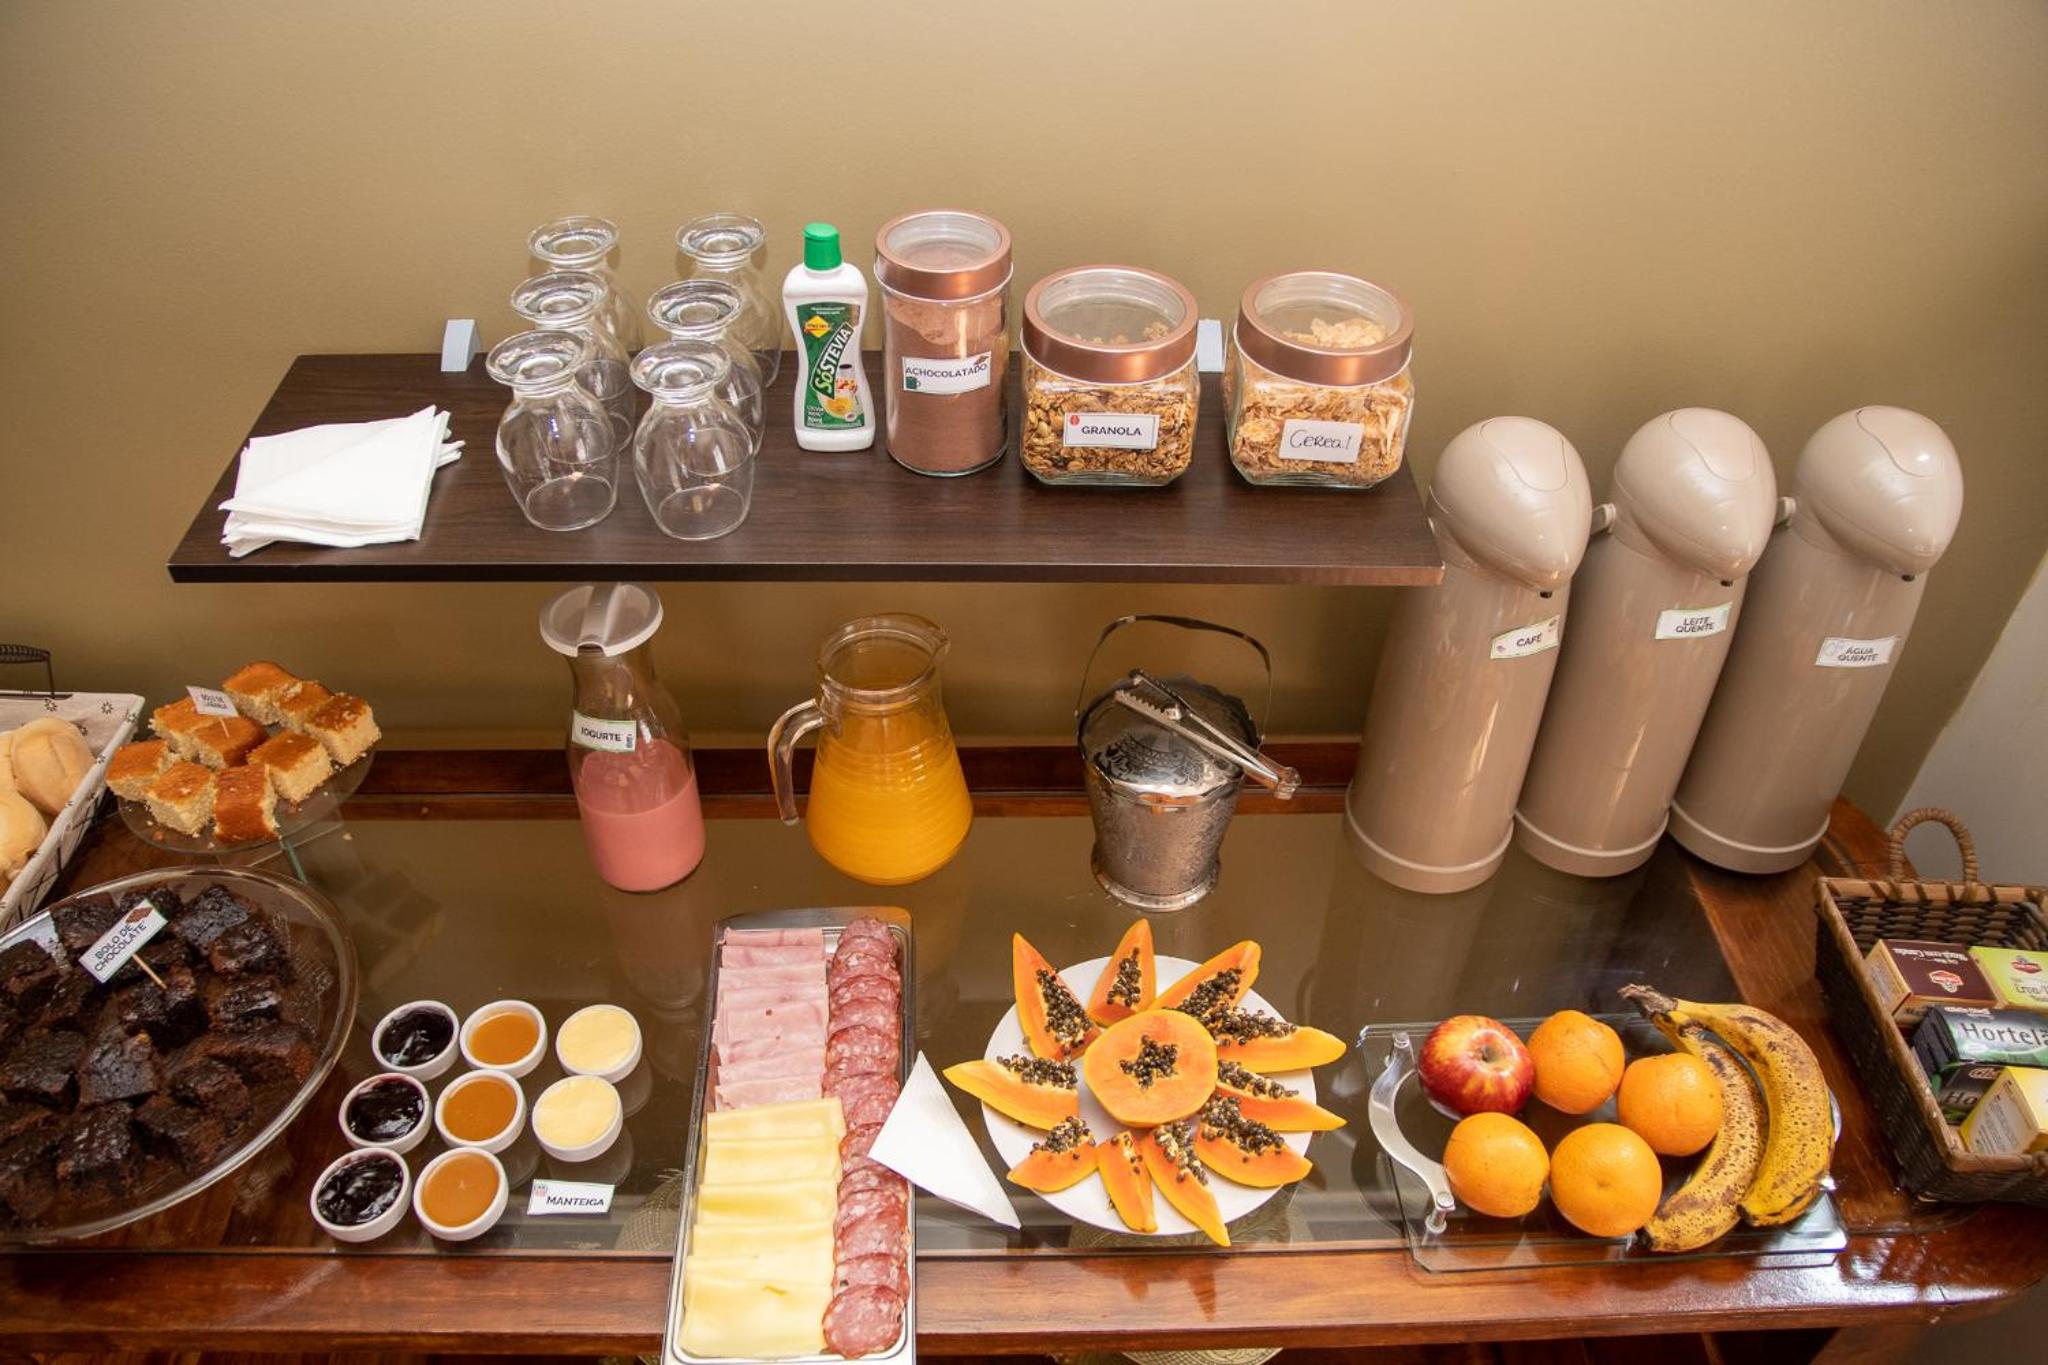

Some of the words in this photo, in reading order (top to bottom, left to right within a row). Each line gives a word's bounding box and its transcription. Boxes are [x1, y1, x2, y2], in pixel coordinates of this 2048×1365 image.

[905, 363, 988, 378] ACHOCOLATADO
[1081, 425, 1142, 436] GRANOLA
[1683, 616, 1710, 626] LEITE
[1675, 622, 1713, 633] QUENTE
[1838, 654, 1879, 662] QUENTE
[581, 727, 622, 742] IOGURTE
[94, 935, 120, 960] BOLO
[119, 923, 134, 937] DE
[94, 922, 147, 972] CHOCOLATE
[546, 1195, 605, 1207] MANTEIGA
